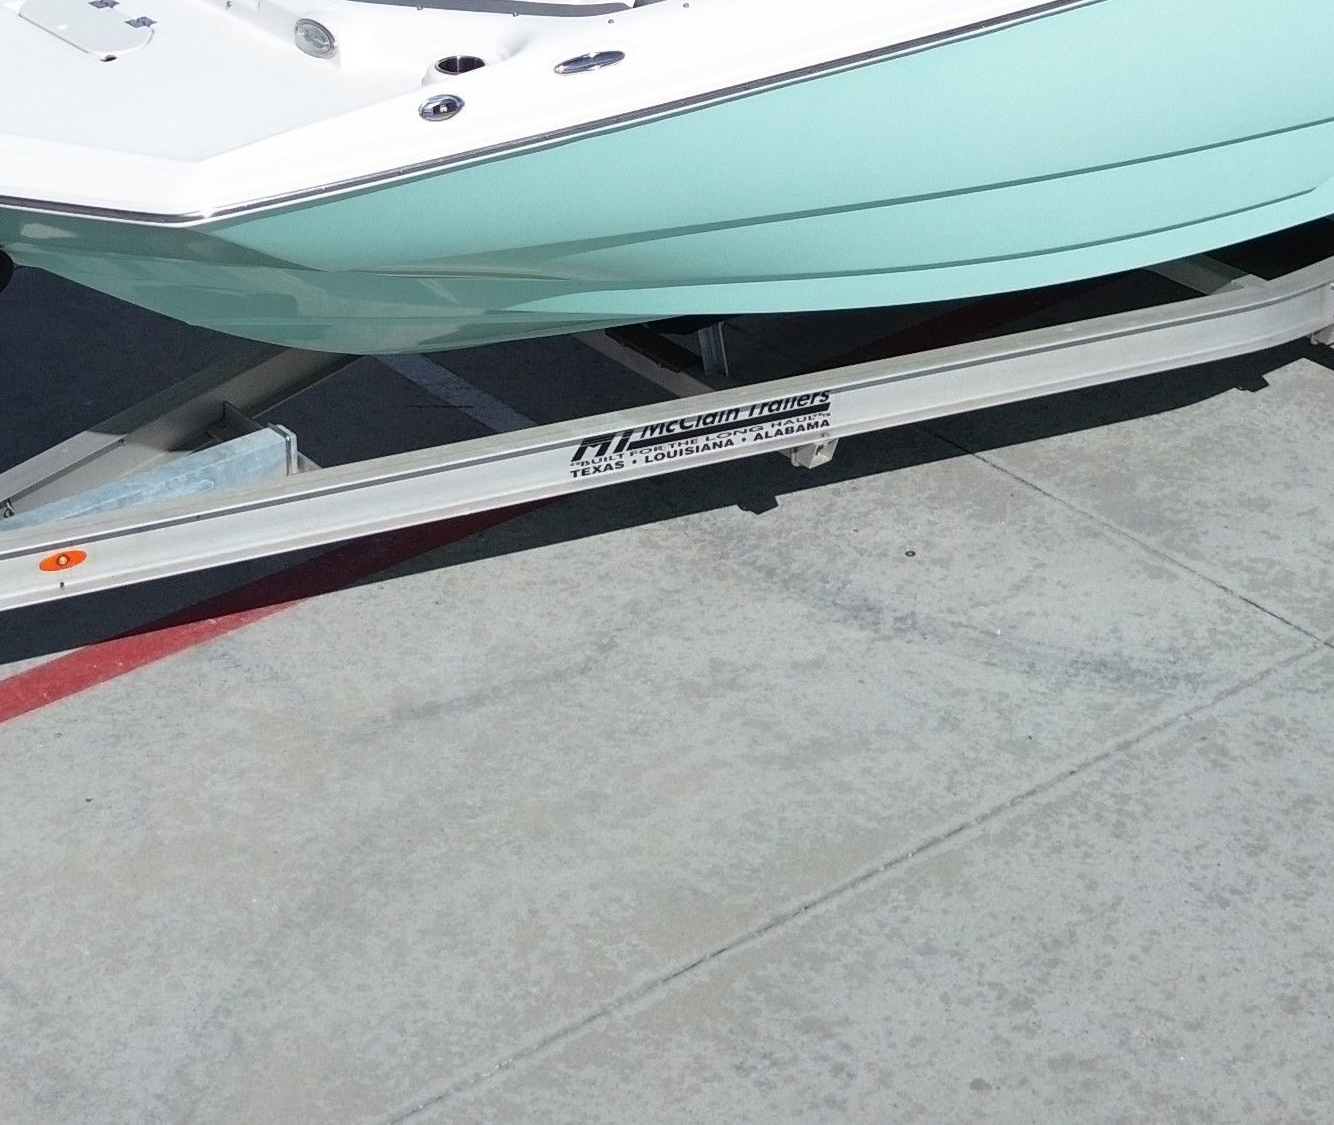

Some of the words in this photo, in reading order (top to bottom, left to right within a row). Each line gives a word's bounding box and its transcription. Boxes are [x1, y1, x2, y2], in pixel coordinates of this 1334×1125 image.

[640, 406, 740, 440] McClain
[570, 460, 625, 478] TEXAS
[645, 438, 735, 464] LOUISIANA
[753, 419, 831, 442] ALABAMA
[630, 445, 663, 457] FOR
[668, 438, 698, 449] THE
[705, 426, 765, 442] LONG
